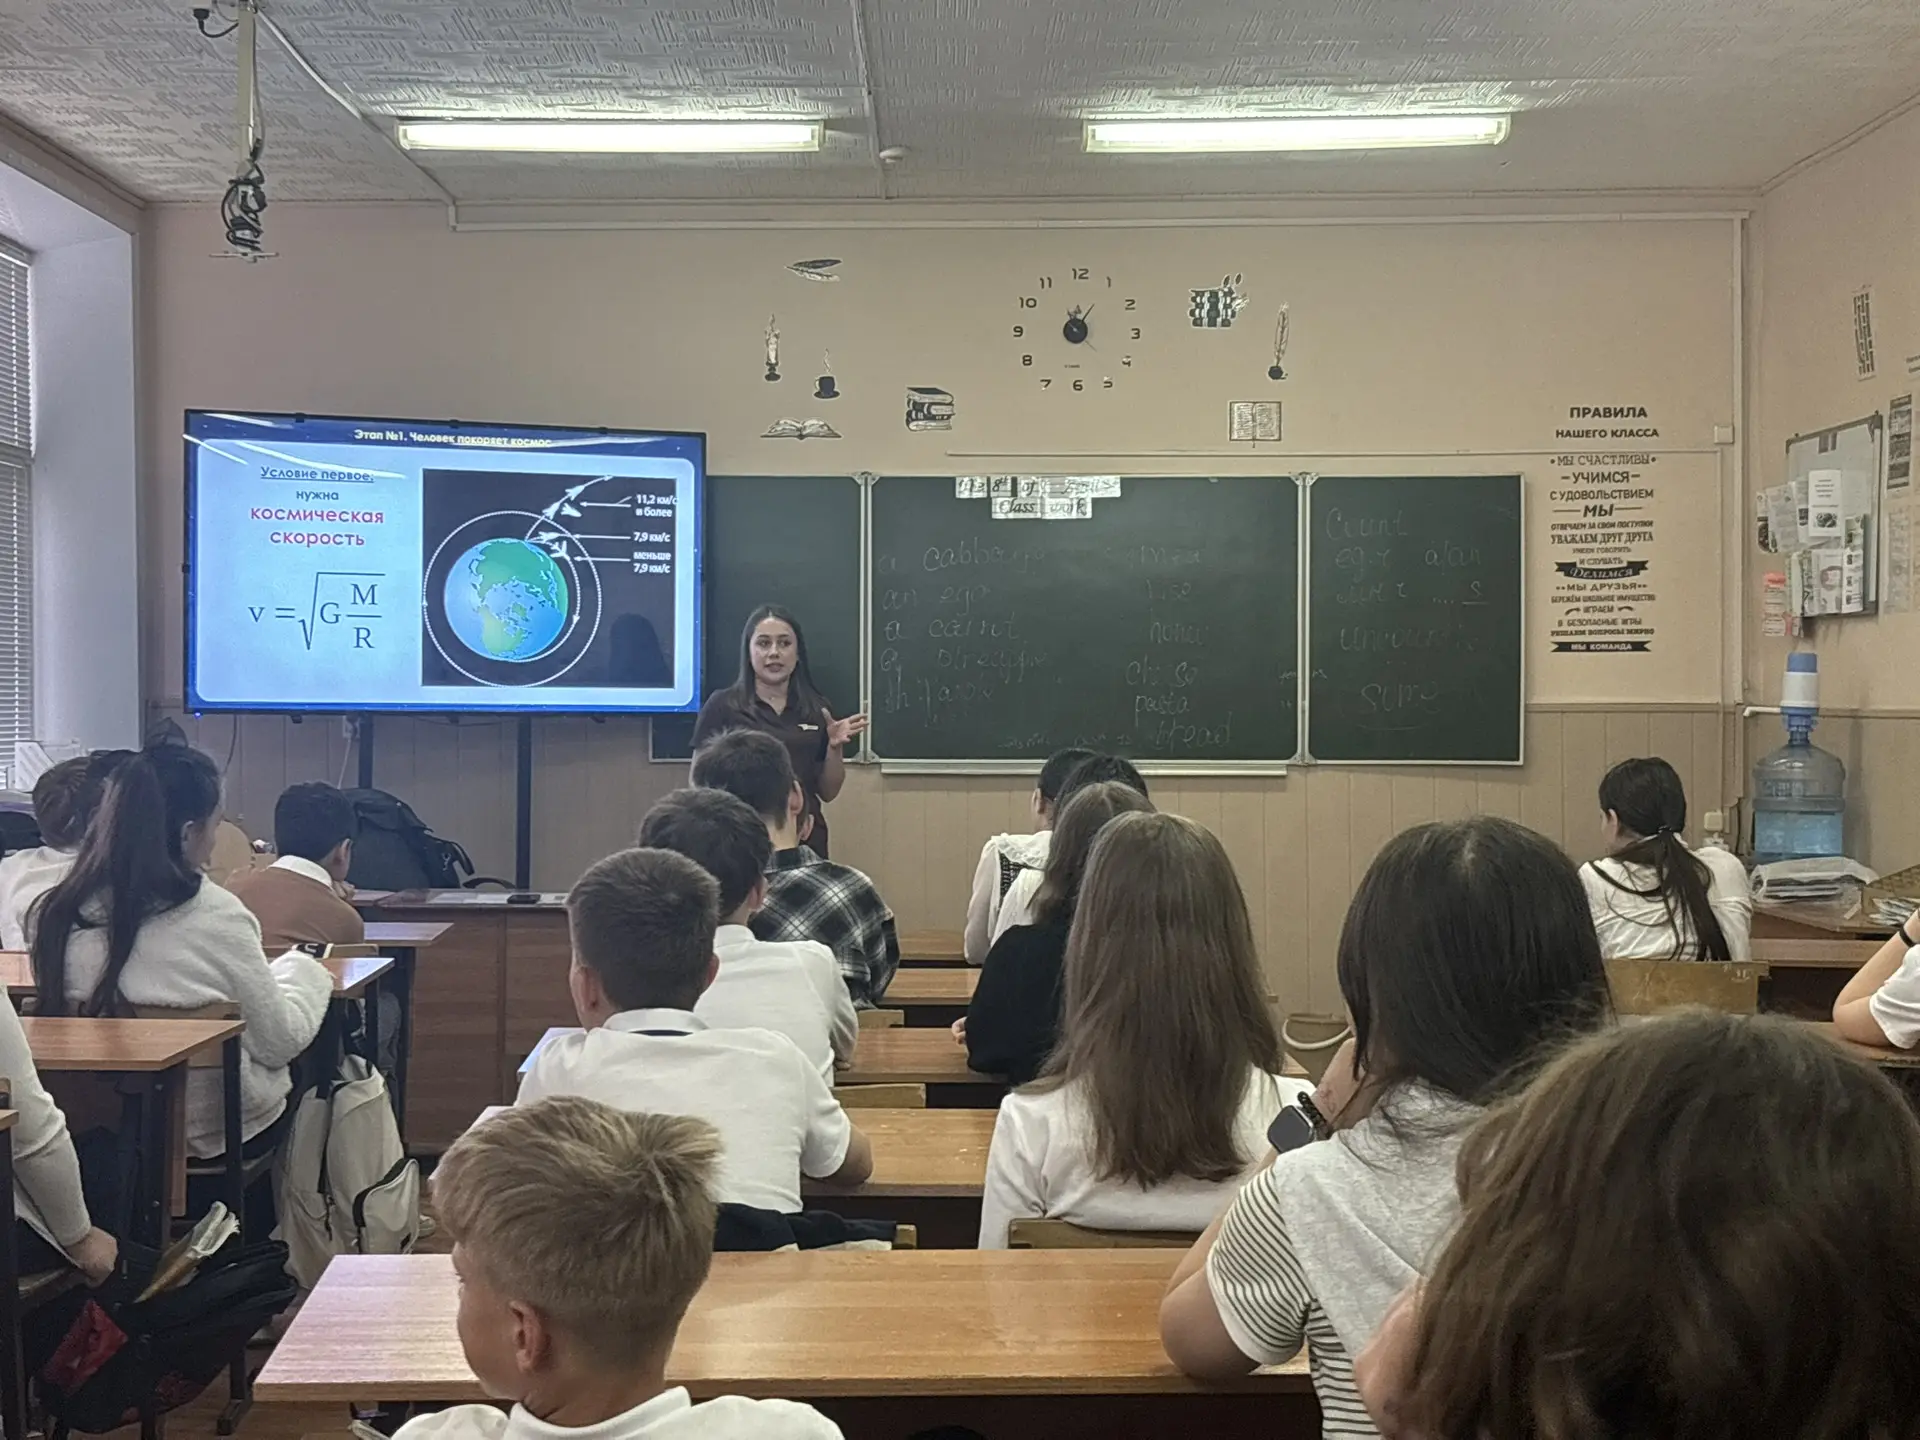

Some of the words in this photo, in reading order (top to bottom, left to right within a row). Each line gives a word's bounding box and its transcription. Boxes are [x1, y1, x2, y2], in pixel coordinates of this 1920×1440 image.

[1072, 268, 1089, 280] 12
[1040, 276, 1052, 289] 11
[1106, 276, 1112, 288] 1
[1019, 296, 1037, 308] 10
[1125, 299, 1136, 310] 2
[1013, 326, 1024, 337] 9
[1131, 328, 1141, 340] 3
[1022, 354, 1033, 366] 8
[1040, 379, 1052, 390] 7
[1073, 380, 1083, 391] 6
[1569, 406, 1648, 418] ПРАВИЛА
[354, 429, 383, 440] Этап
[385, 430, 407, 442] №1.
[410, 431, 455, 443] Человек
[457, 435, 507, 447] покоряет
[511, 438, 552, 448] космос
[1556, 429, 1607, 438] НАШЕГО
[1611, 428, 1659, 438] КЛАССА
[1557, 455, 1574, 466] МЫ
[1577, 454, 1650, 466] СЧАСТЛИВЫ
[260, 466, 318, 480] Условие
[1572, 471, 1630, 484] УЧИМСЯ
[296, 490, 339, 502] нужна
[636, 494, 656, 505] 11,2
[656, 495, 680, 505] км/с
[1550, 491, 1557, 501] С
[1559, 489, 1654, 502] УДОВОЛЬСТВИЕМ
[251, 508, 384, 524] космическая
[635, 508, 643, 516] и
[644, 506, 673, 517] более
[1583, 504, 1614, 517] МЫ
[1551, 523, 1586, 531] ОТВЕЧАЕМ
[1597, 521, 1616, 529] СВОИ
[1617, 520, 1654, 528] ПОСТУПКИ
[270, 531, 365, 548] скорость
[633, 531, 649, 542] 7,9
[649, 532, 671, 542] км/с
[1551, 533, 1598, 544] УВАЖАЕМ
[1600, 532, 1623, 545] ДРУГ
[1624, 531, 1653, 544] ДРУГА
[633, 551, 672, 560] меньше
[1586, 557, 1623, 565] СЛУШАТЬ
[633, 563, 649, 574] 7,9
[649, 563, 671, 574] км/с
[1569, 567, 1634, 578] Делимся
[1590, 582, 1637, 591] ДРУЗЬЯ
[351, 583, 378, 605] M
[320, 602, 342, 624] G
[353, 627, 375, 649] R
